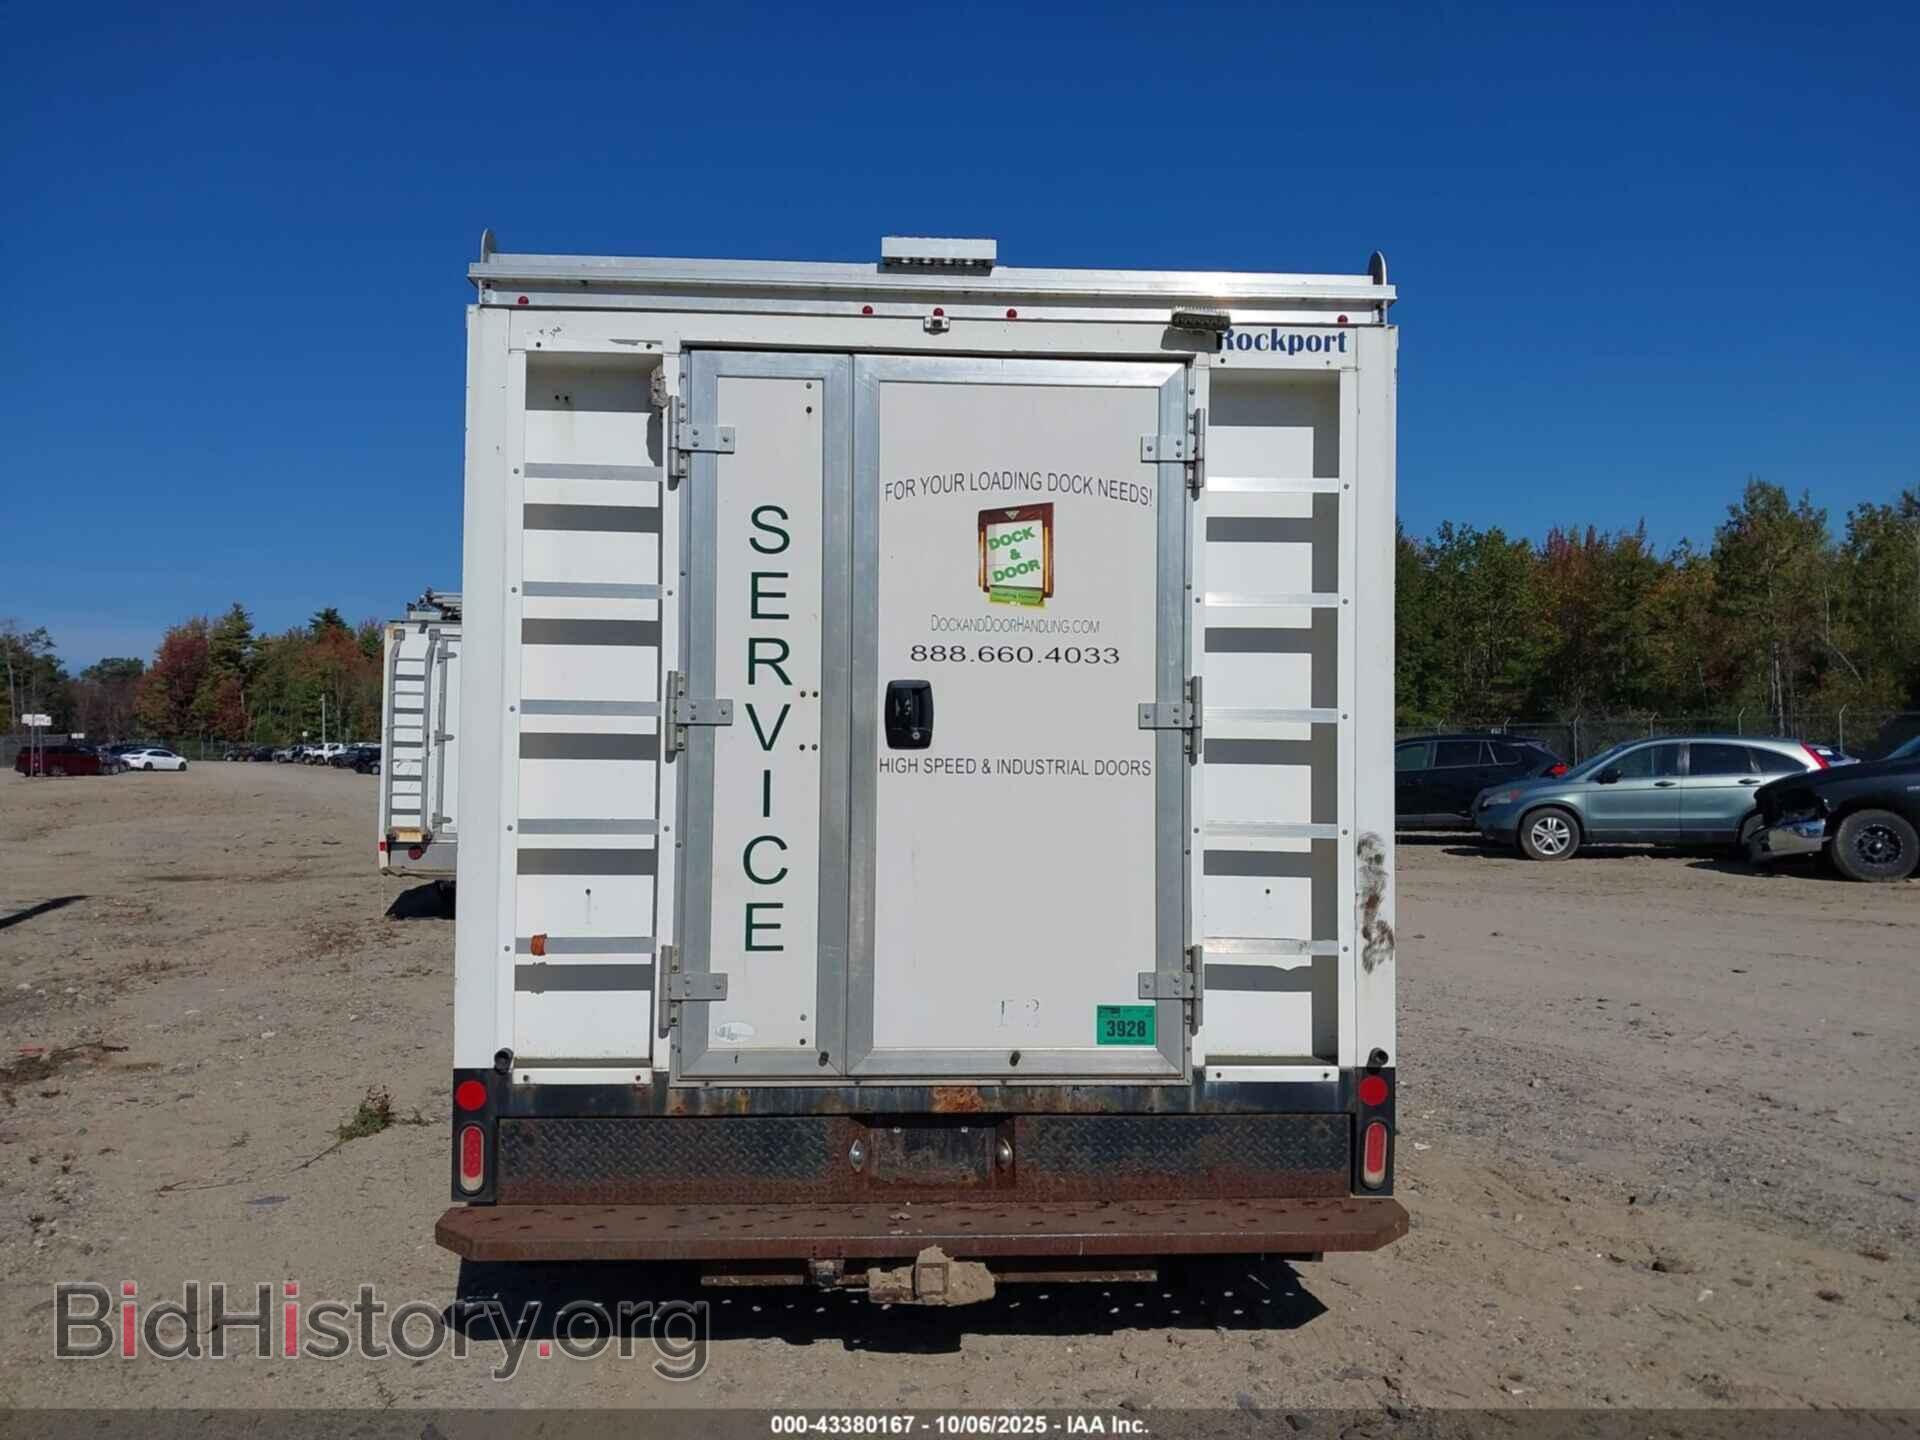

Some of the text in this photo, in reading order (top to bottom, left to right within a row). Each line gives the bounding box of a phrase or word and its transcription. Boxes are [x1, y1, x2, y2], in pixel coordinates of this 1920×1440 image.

[1216, 328, 1347, 355] Rockport
[885, 470, 1153, 507] FOR YOUR LOADING DOCK NEEDS!
[988, 526, 1036, 551] DOCK
[1009, 548, 1022, 561] &
[992, 559, 1041, 582] DOOR
[910, 645, 1120, 665] 888.660.4033
[742, 505, 793, 952] SERVICE
[879, 757, 1151, 777] HIGH SPEED & INDUSTRIAL DOORS
[1106, 1020, 1146, 1038] 3928
